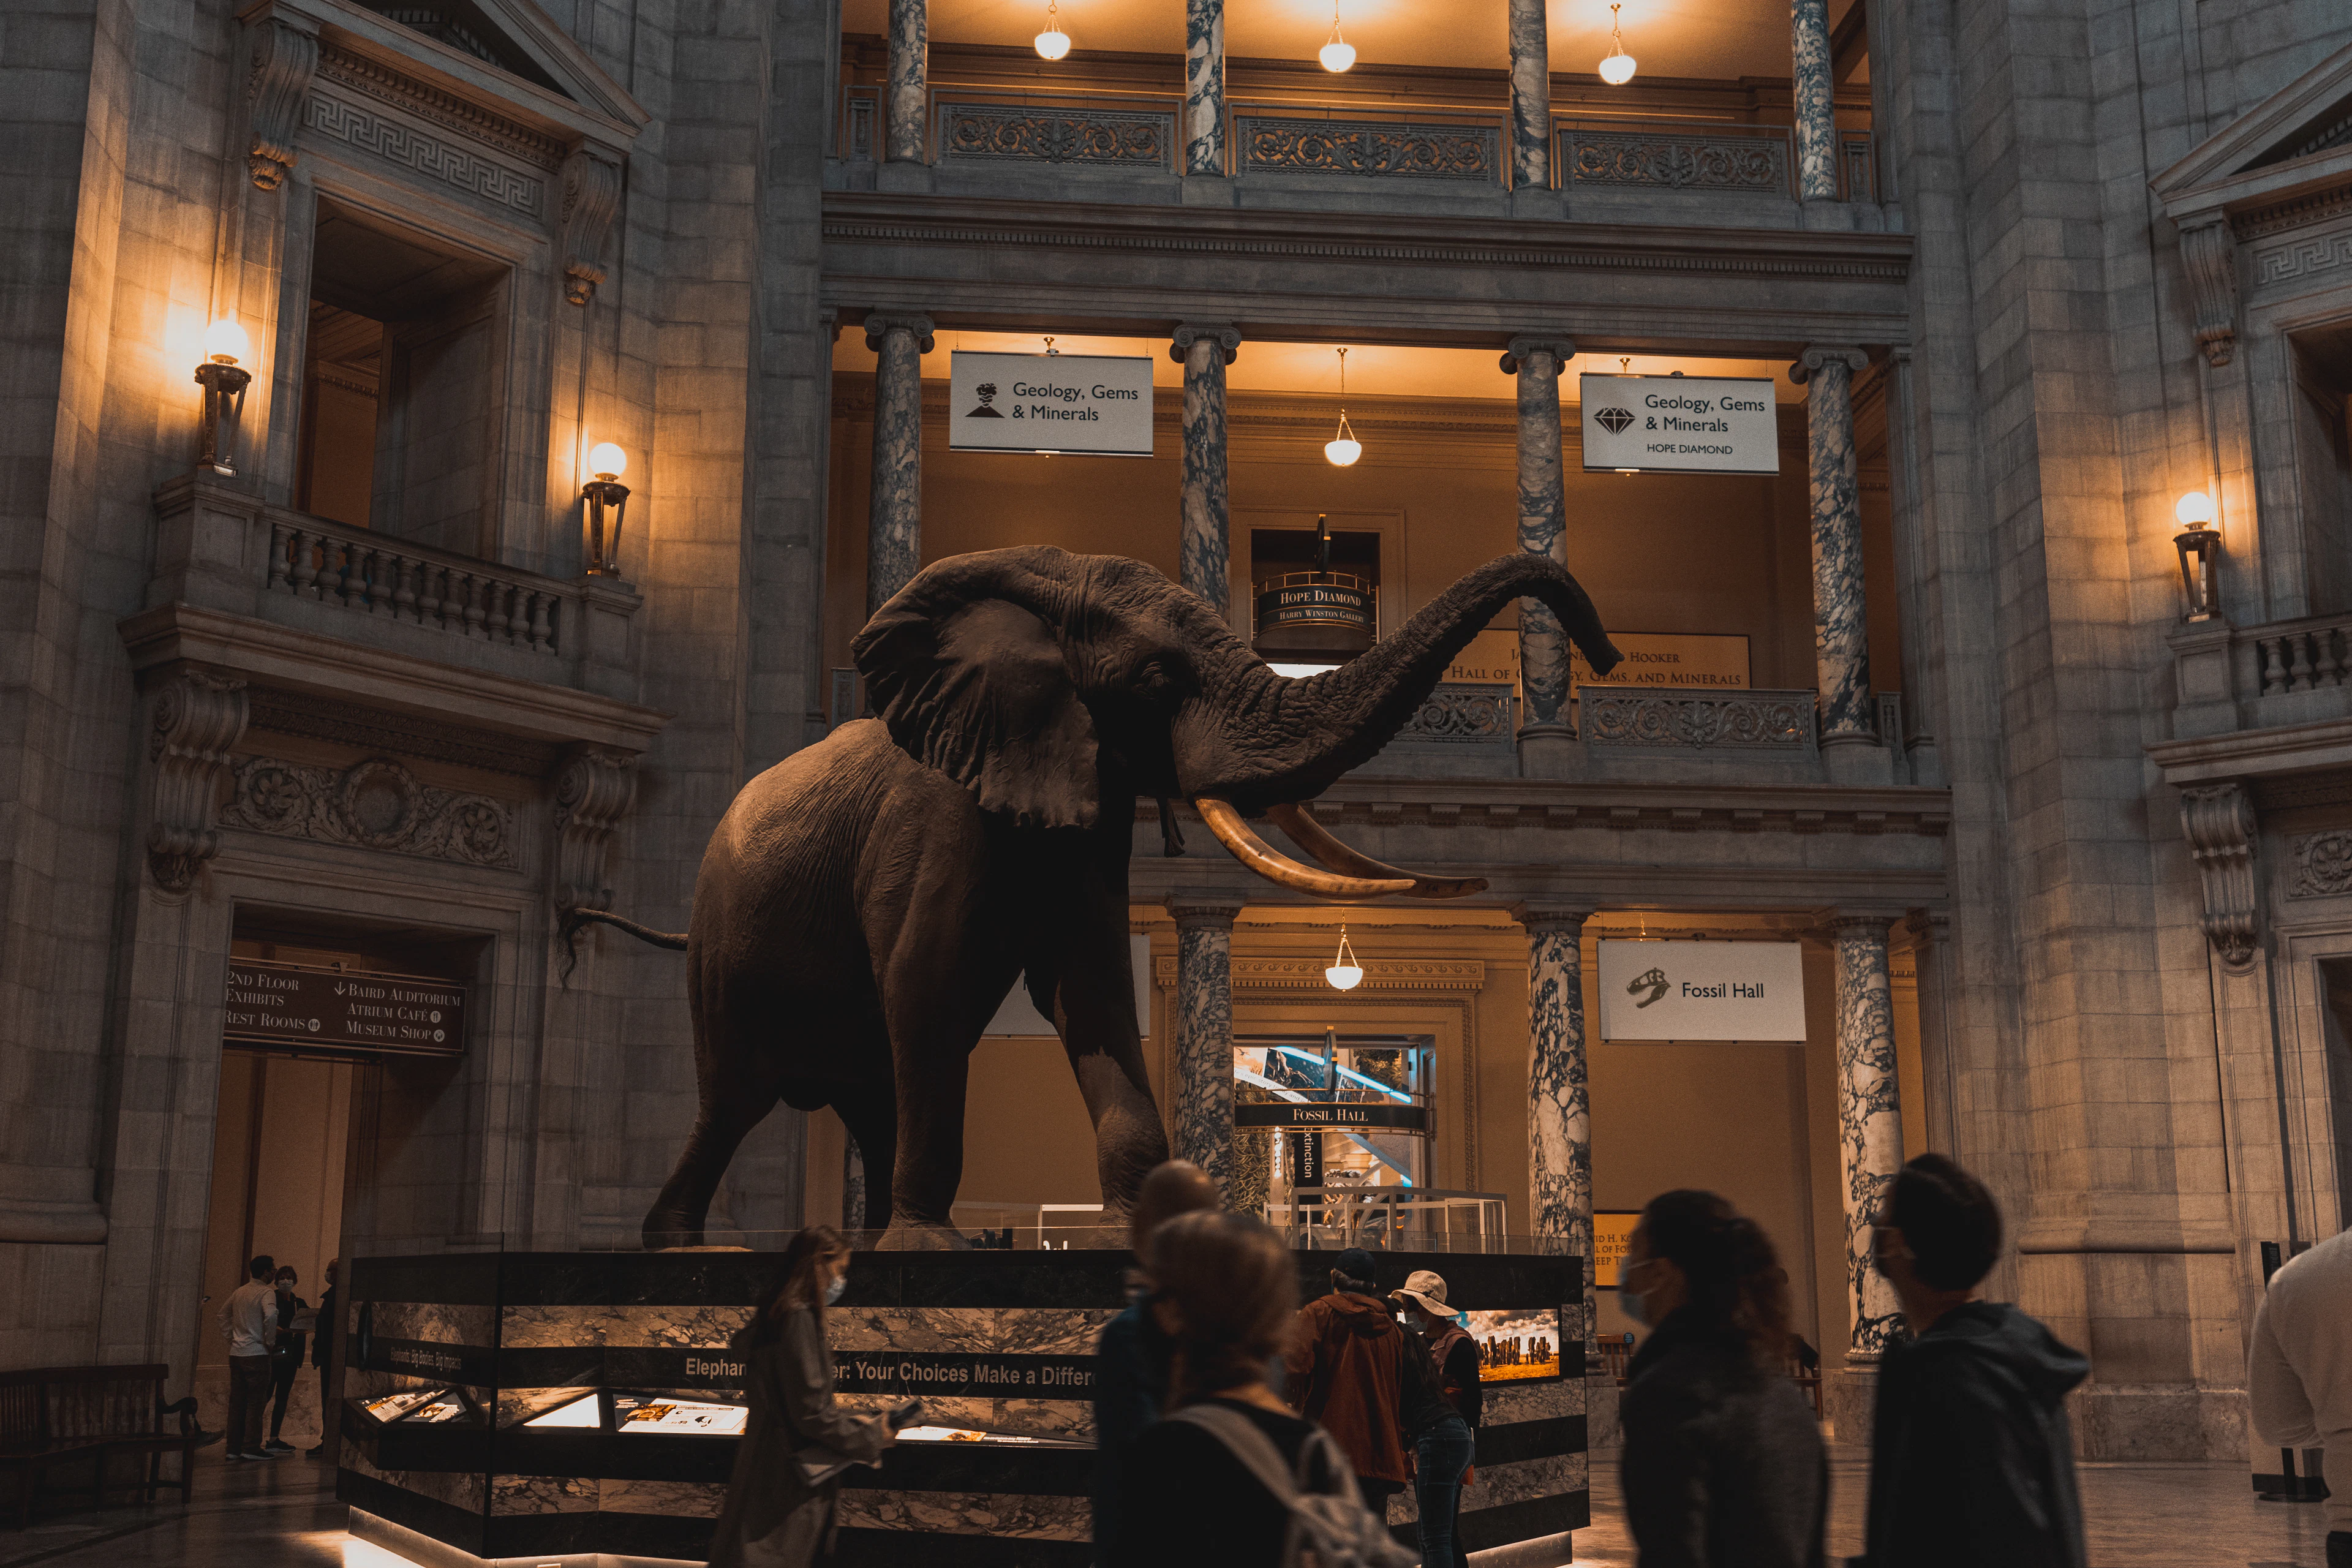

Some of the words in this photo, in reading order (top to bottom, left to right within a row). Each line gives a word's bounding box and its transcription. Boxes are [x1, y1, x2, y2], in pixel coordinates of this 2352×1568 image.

[1013, 382, 1085, 401] Geology,
[1091, 385, 1138, 400] Gems
[1645, 394, 1714, 413] Geology,
[1721, 397, 1765, 412] Gems
[1012, 405, 1025, 419] &
[1031, 405, 1099, 421] Minerals
[1646, 417, 1657, 430] &
[1664, 417, 1728, 432] Minerals
[1647, 443, 1676, 453] HOPE
[1679, 445, 1733, 454] DIAMOND
[1281, 592, 1311, 604] HOPE
[1314, 590, 1361, 606] DIAMOND
[1280, 611, 1302, 620] HARRY
[1306, 609, 1338, 618] WINSTON
[1340, 611, 1364, 623] GALLERY
[1630, 652, 1680, 663] HOOKER
[1452, 666, 1488, 679] HALL
[1493, 669, 1510, 679] OF
[1635, 673, 1665, 683] AND
[1670, 673, 1741, 685] MINERALS
[227, 971, 252, 986] 2ND
[257, 974, 299, 990] FLOOR
[226, 988, 284, 1006] EXHIBITS
[349, 984, 385, 1000] BAIRD
[390, 988, 461, 1006] AUDITORIUM
[1683, 982, 1726, 998] Fossil
[1733, 983, 1764, 998] Hall
[225, 1010, 255, 1025] REST
[260, 1013, 305, 1030] ROOMS
[347, 1003, 393, 1018] ATRIUM
[398, 1007, 428, 1022] CAFÉ
[346, 1020, 396, 1037] MUSEUM
[401, 1026, 431, 1041] SHOP
[1293, 1109, 1332, 1121] FOSSIL
[1336, 1109, 1368, 1121] HALL
[1621, 1234, 1634, 1243] KO
[1596, 1257, 1611, 1265] EEP
[443, 1352, 461, 1373] Impacts
[685, 1357, 747, 1379] Elephan
[832, 1365, 850, 1380] er:
[855, 1362, 895, 1381] Your
[899, 1362, 969, 1384] Choices
[974, 1364, 1020, 1384] Make
[1025, 1370, 1036, 1384] a
[1042, 1366, 1096, 1385] Differ
